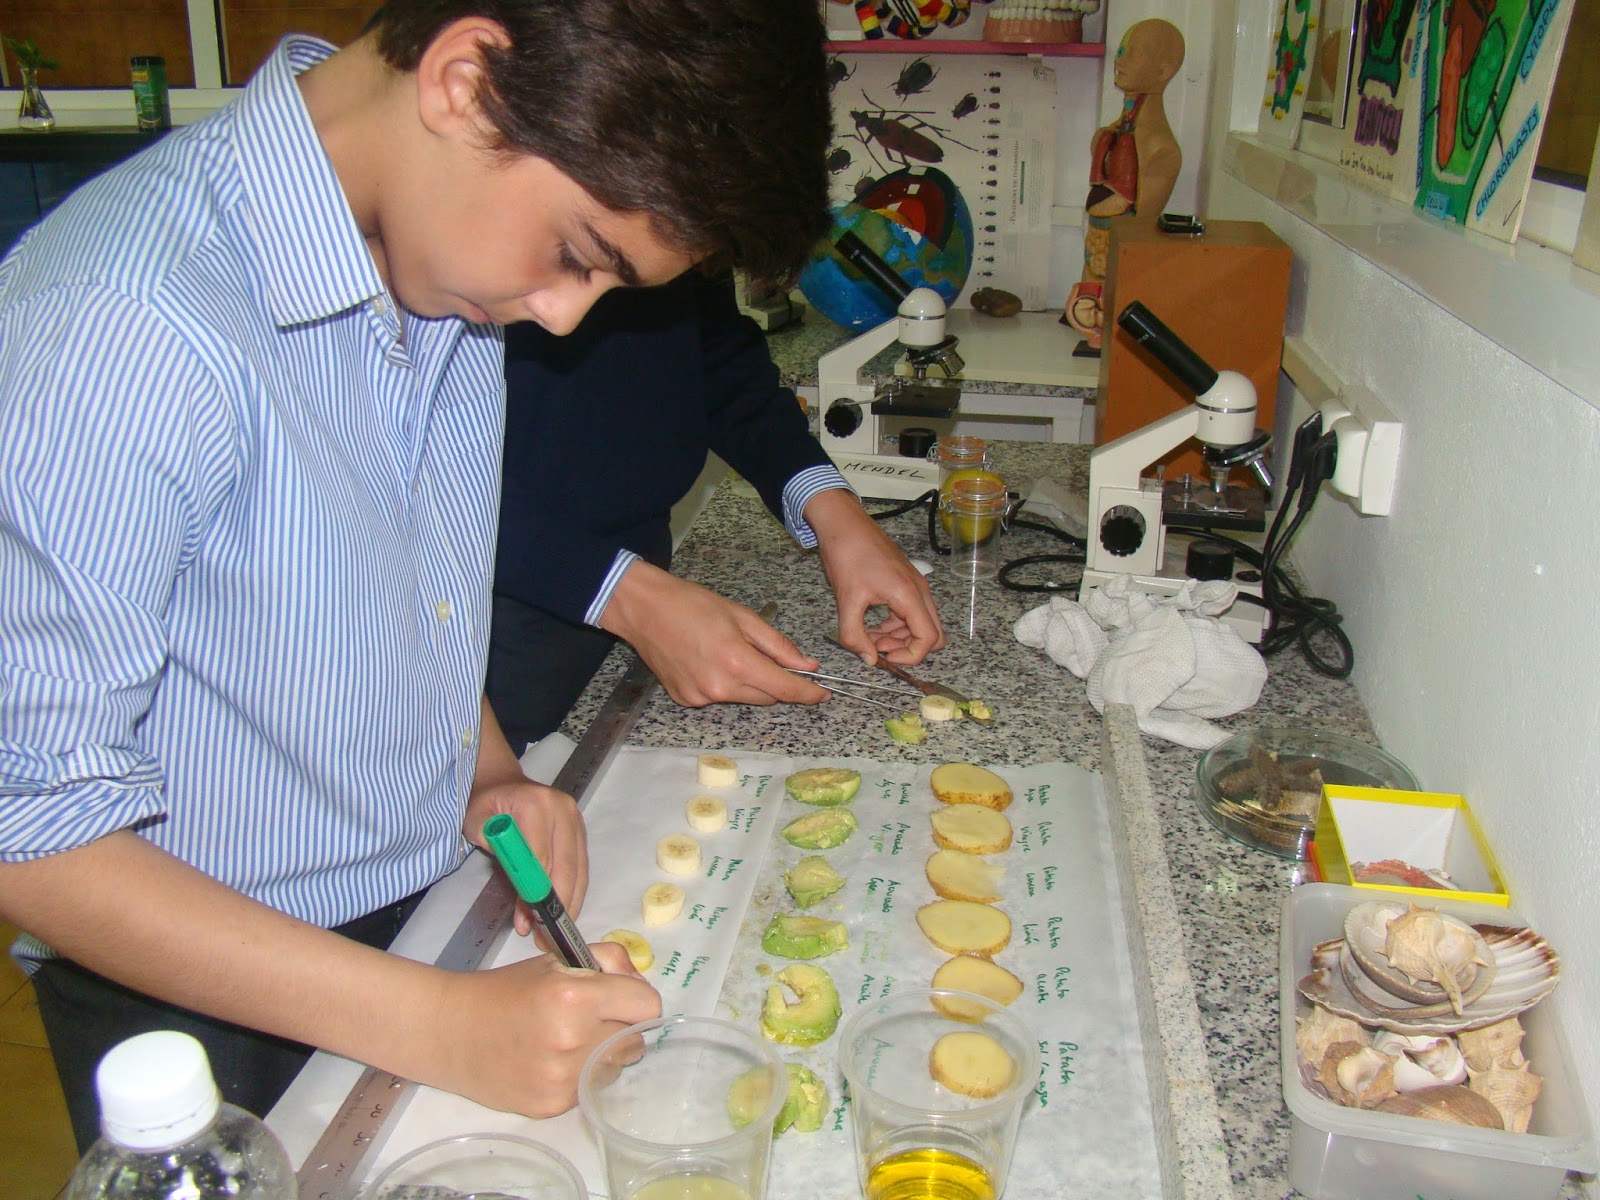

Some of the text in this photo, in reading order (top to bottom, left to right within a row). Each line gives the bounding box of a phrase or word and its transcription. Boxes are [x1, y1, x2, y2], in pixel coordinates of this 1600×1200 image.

[843, 462, 925, 479] MENDEL
[1048, 916, 1063, 949] Patata
[1058, 1041, 1079, 1085] Patata
